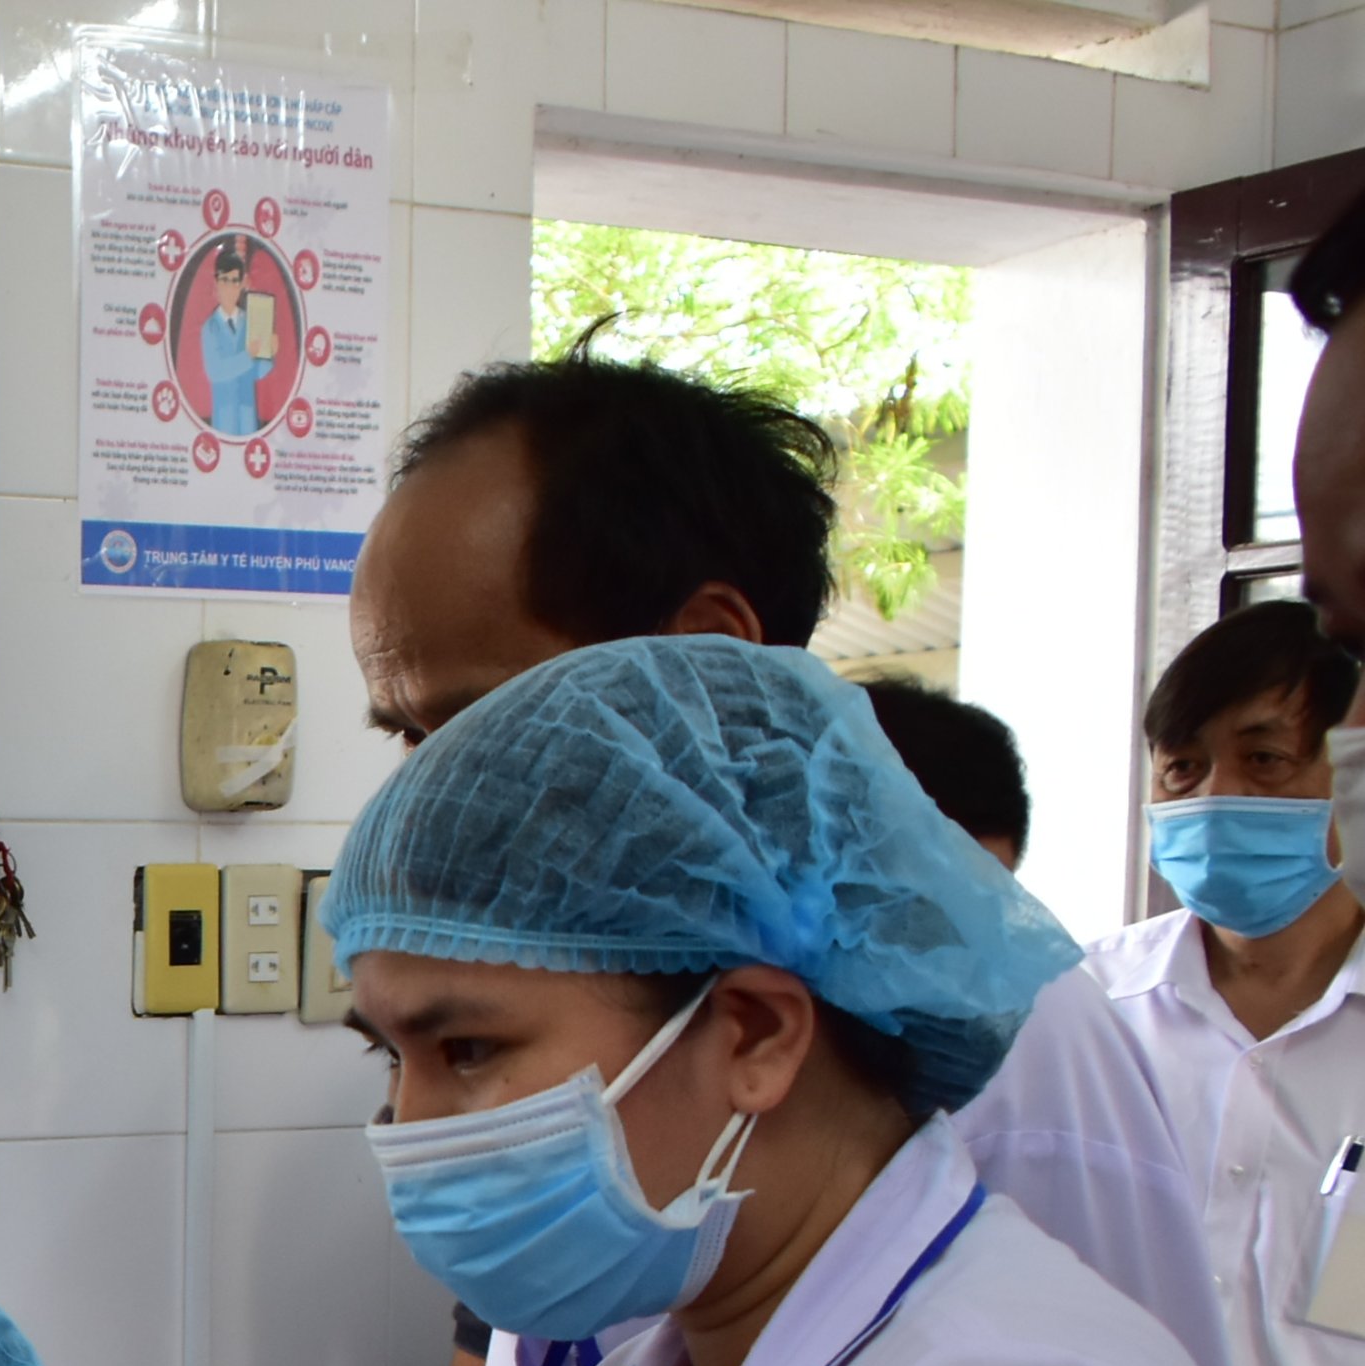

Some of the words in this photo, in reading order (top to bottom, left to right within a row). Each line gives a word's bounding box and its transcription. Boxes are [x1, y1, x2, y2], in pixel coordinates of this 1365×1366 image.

[164, 128, 227, 156] khuyến
[233, 134, 260, 157] cáo
[264, 137, 289, 160] với
[293, 138, 340, 168] người
[343, 145, 374, 171] dân
[144, 550, 189, 565] TRUNG
[191, 550, 218, 566] TÂM
[220, 552, 231, 566] Y
[232, 551, 248, 568] TẾ
[251, 554, 292, 572] HUYỆN
[295, 556, 321, 571] PHÚ
